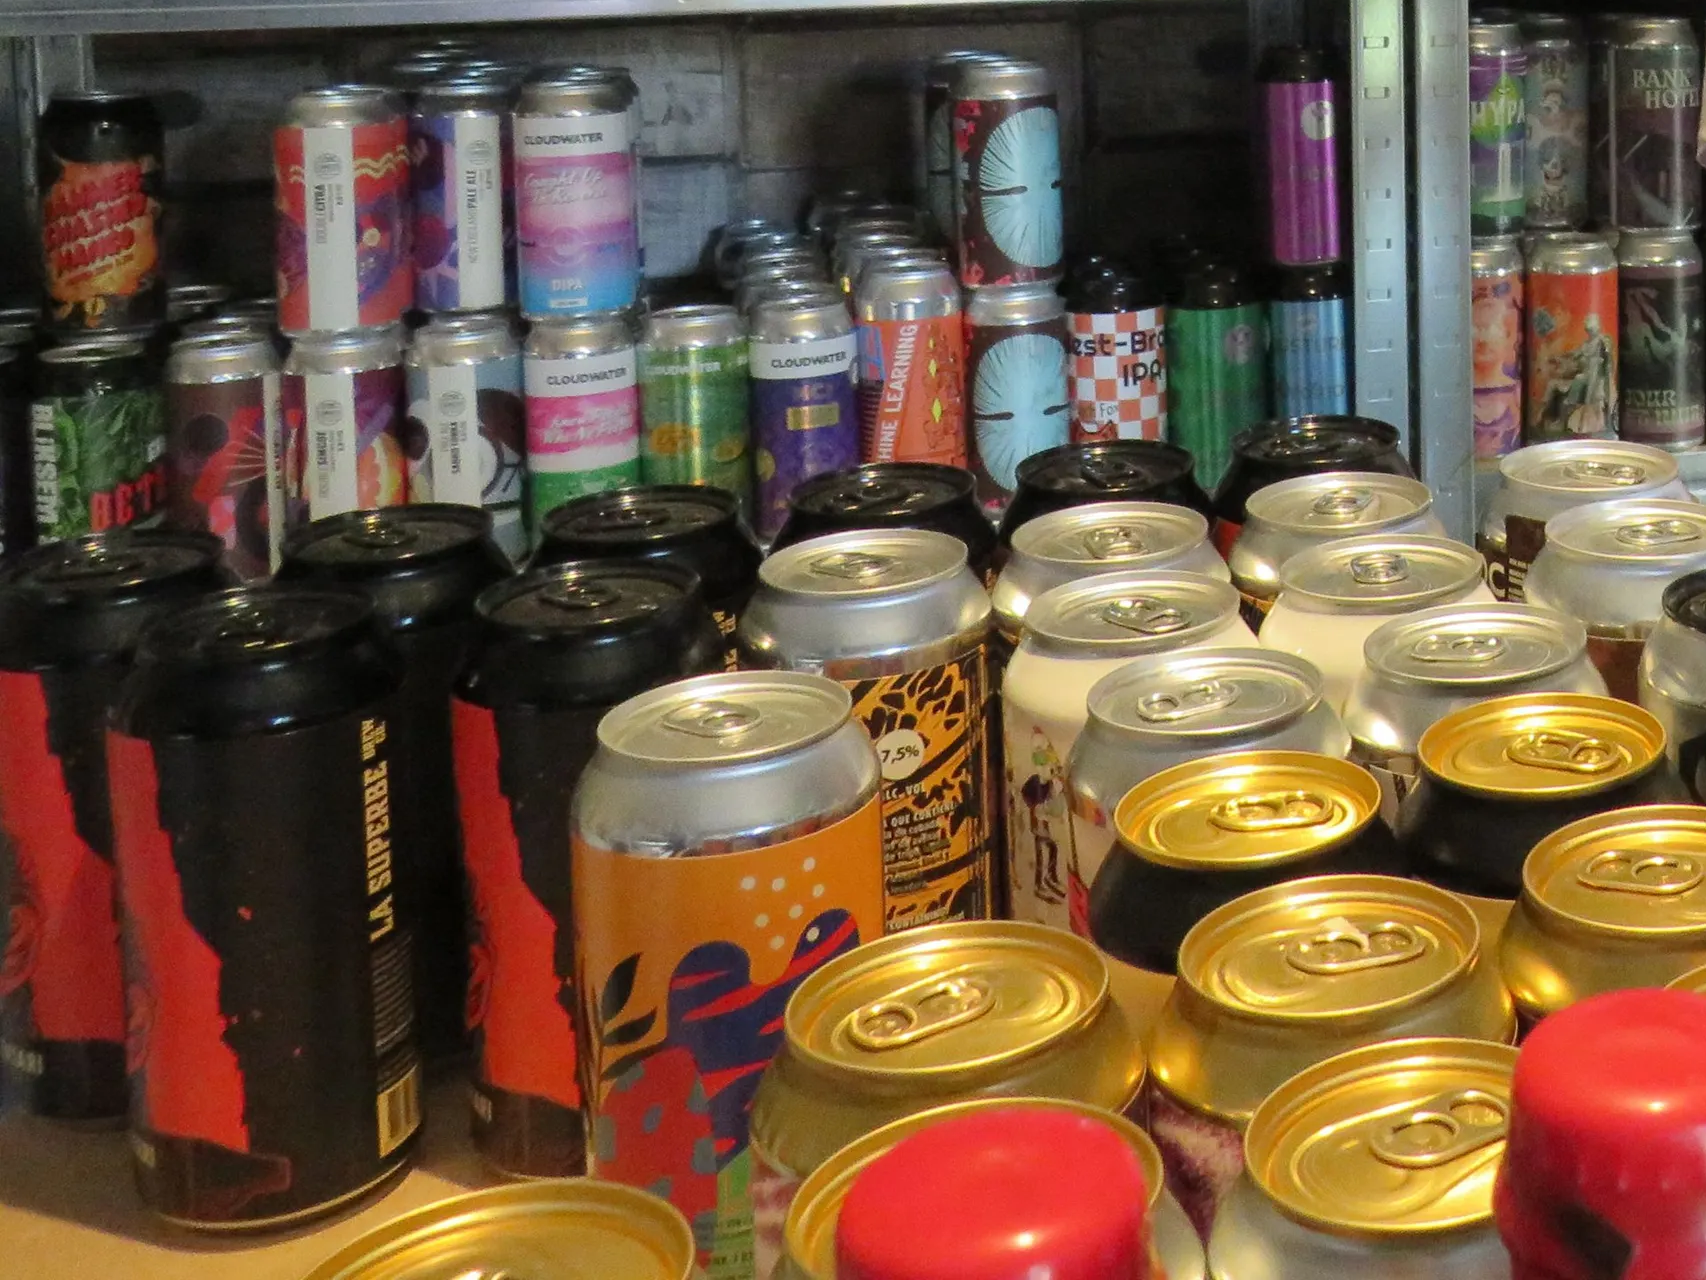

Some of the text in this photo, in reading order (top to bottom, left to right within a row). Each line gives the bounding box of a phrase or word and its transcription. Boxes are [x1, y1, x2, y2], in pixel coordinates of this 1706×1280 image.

[524, 132, 604, 146] CLOUDWATER
[770, 351, 847, 369] CLOUDWATER
[884, 323, 919, 414] LEARNING
[546, 367, 628, 386] CLOUDWATER
[881, 745, 920, 765] 7,5%
[363, 760, 393, 896] SUPERBE
[369, 892, 395, 945] LA
